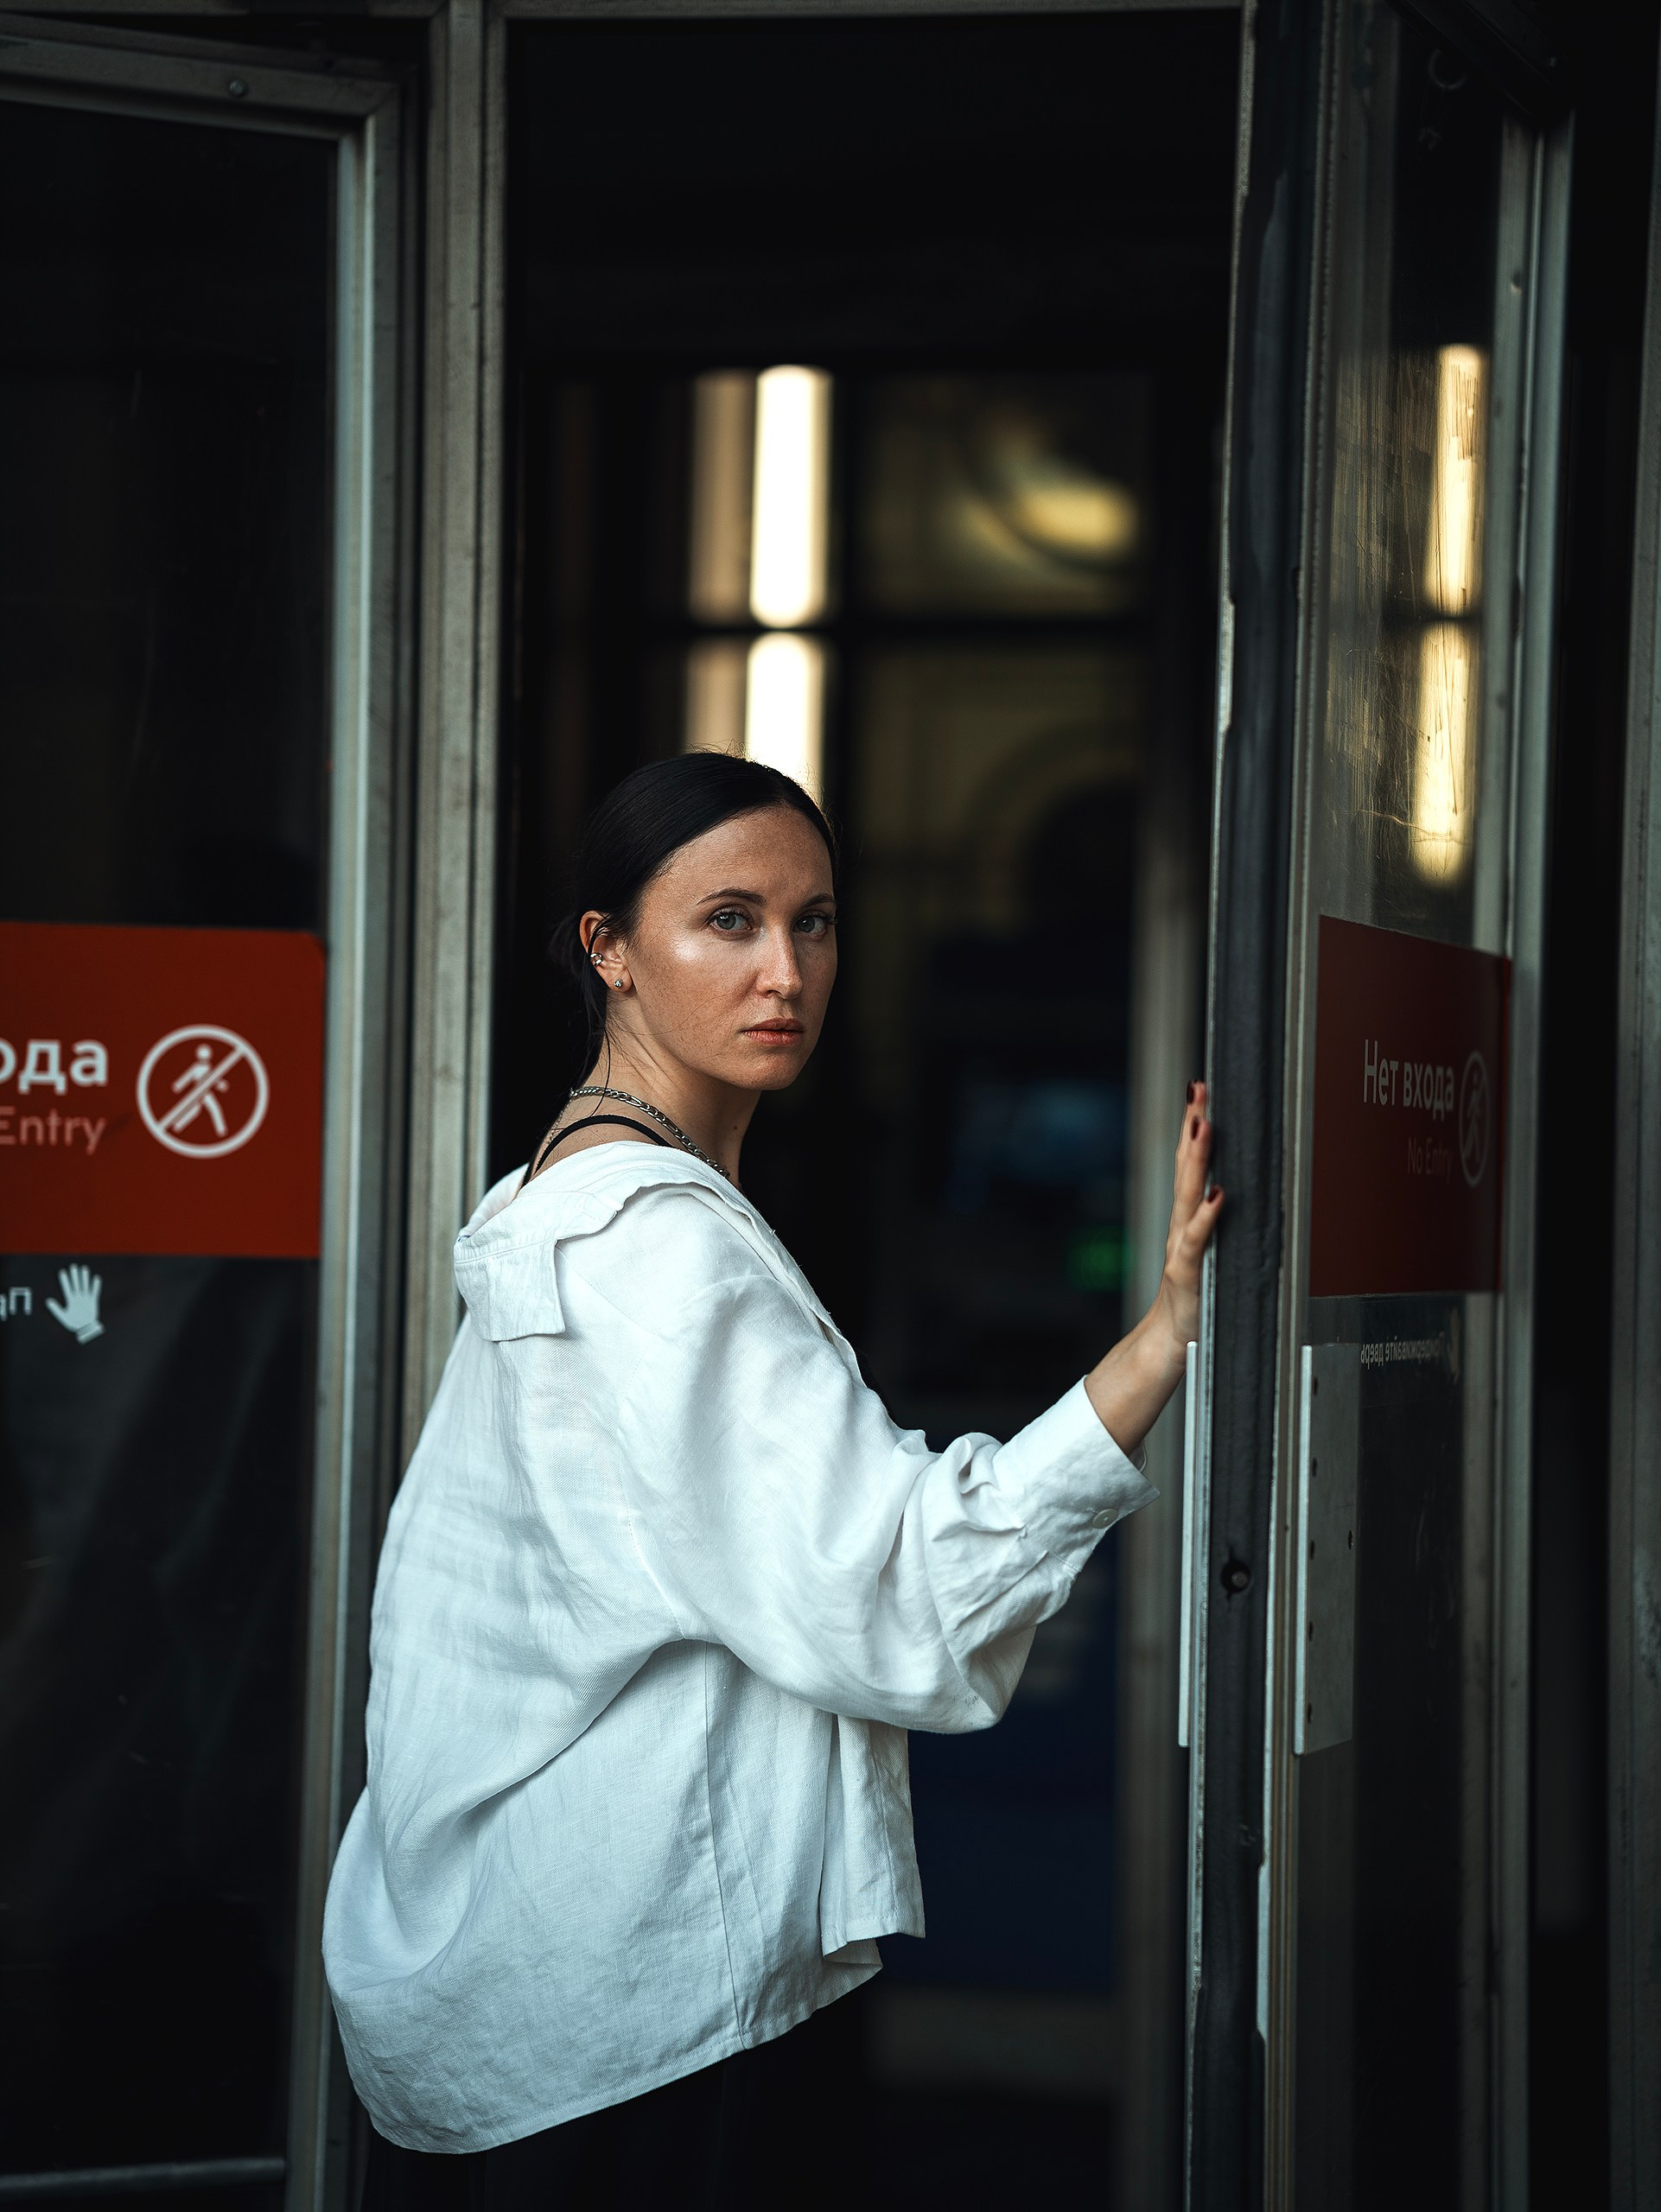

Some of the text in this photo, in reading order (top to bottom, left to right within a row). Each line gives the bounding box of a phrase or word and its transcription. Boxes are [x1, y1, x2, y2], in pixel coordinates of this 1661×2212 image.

[1363, 1039, 1454, 1122] Нет входа
[1407, 1136, 1454, 1185] No Entry
